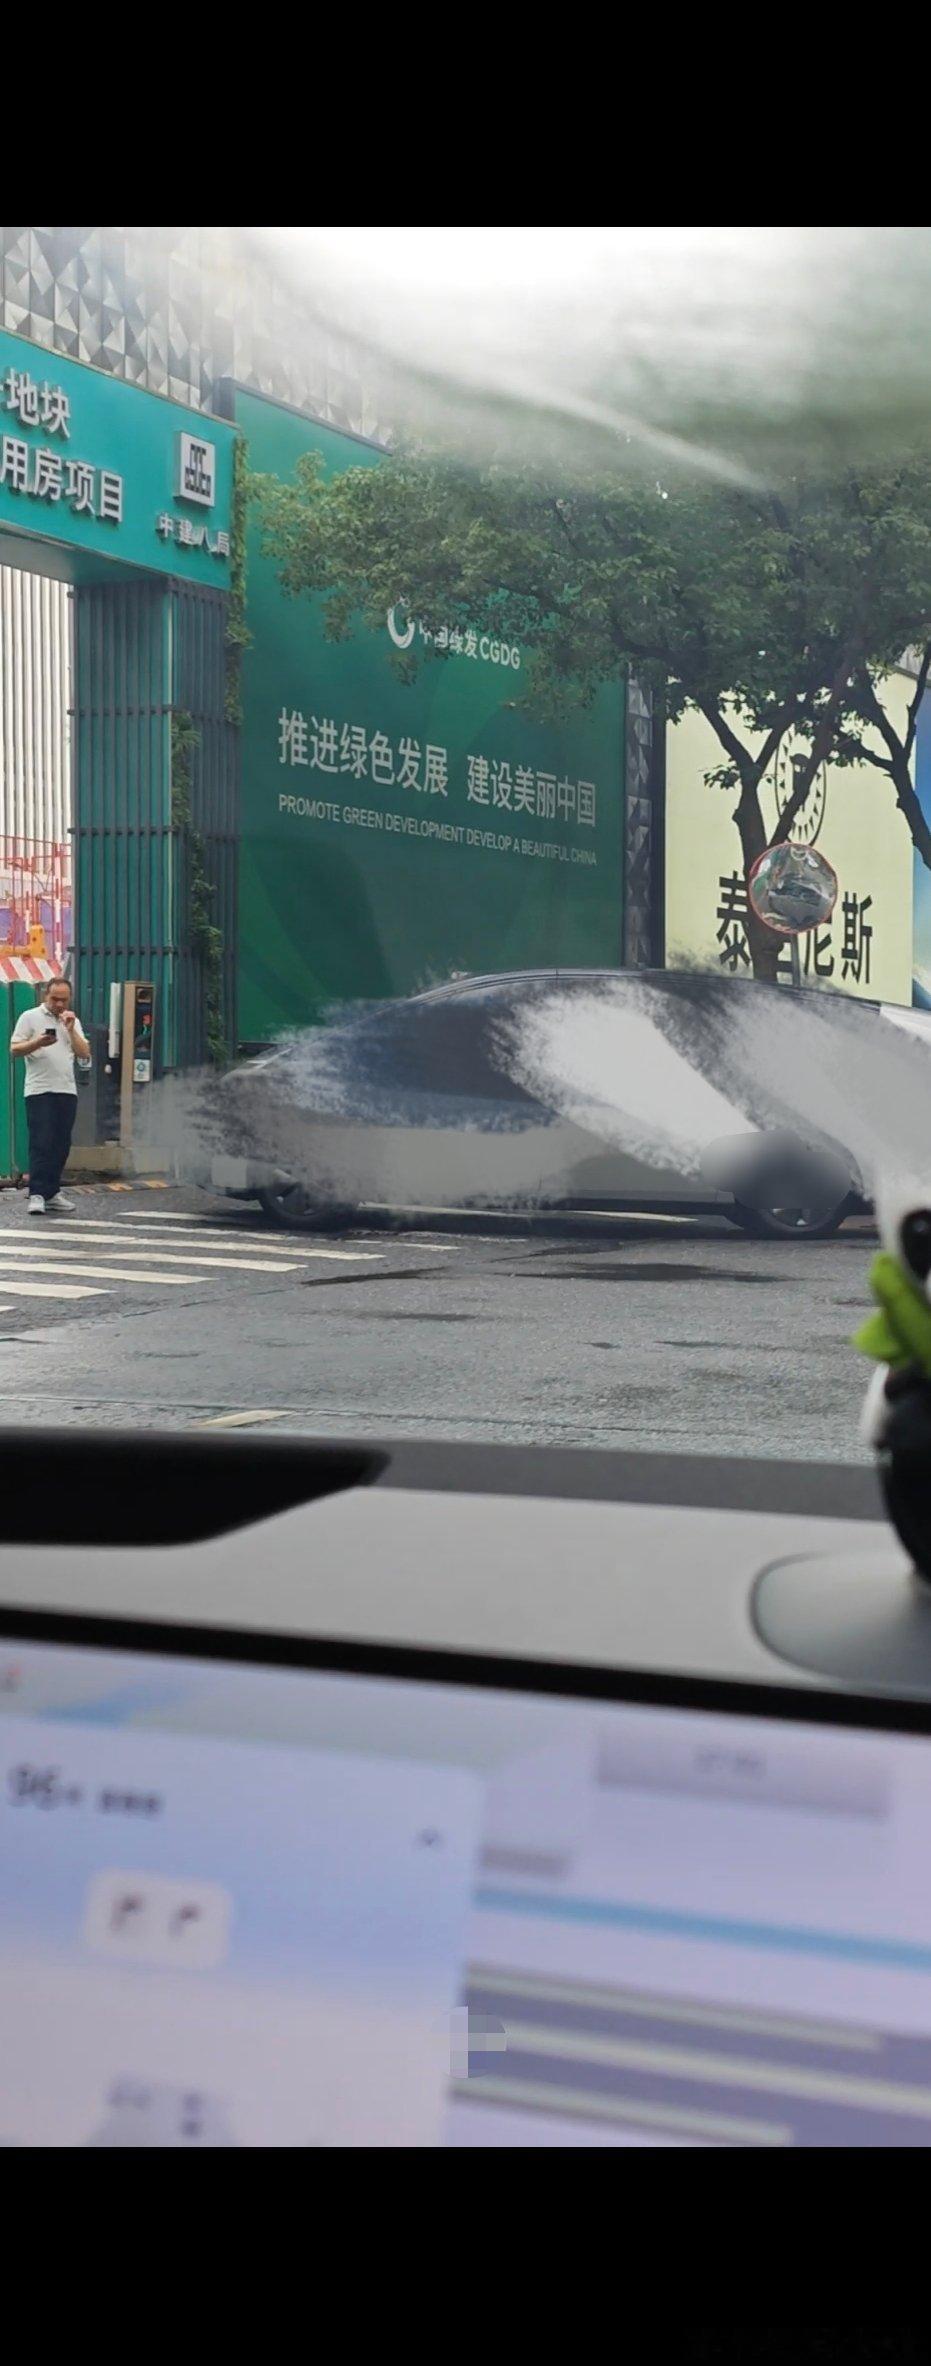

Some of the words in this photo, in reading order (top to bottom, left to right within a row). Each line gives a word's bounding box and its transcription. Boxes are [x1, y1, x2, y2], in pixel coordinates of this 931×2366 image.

[0, 368, 70, 438] 地块
[0, 436, 123, 522] 用房项目
[479, 636, 521, 670] CGDG
[278, 707, 448, 797] 推进绿色发展
[467, 754, 596, 827] 建设美丽中国
[278, 793, 340, 822] PROMOTE
[343, 806, 383, 829] GREEN
[385, 813, 464, 843] DEVELOPMENT
[466, 828, 512, 851] DEVELOP
[513, 838, 520, 853] A
[521, 839, 570, 862] BEAUTIFUL
[571, 847, 597, 866] CHINA
